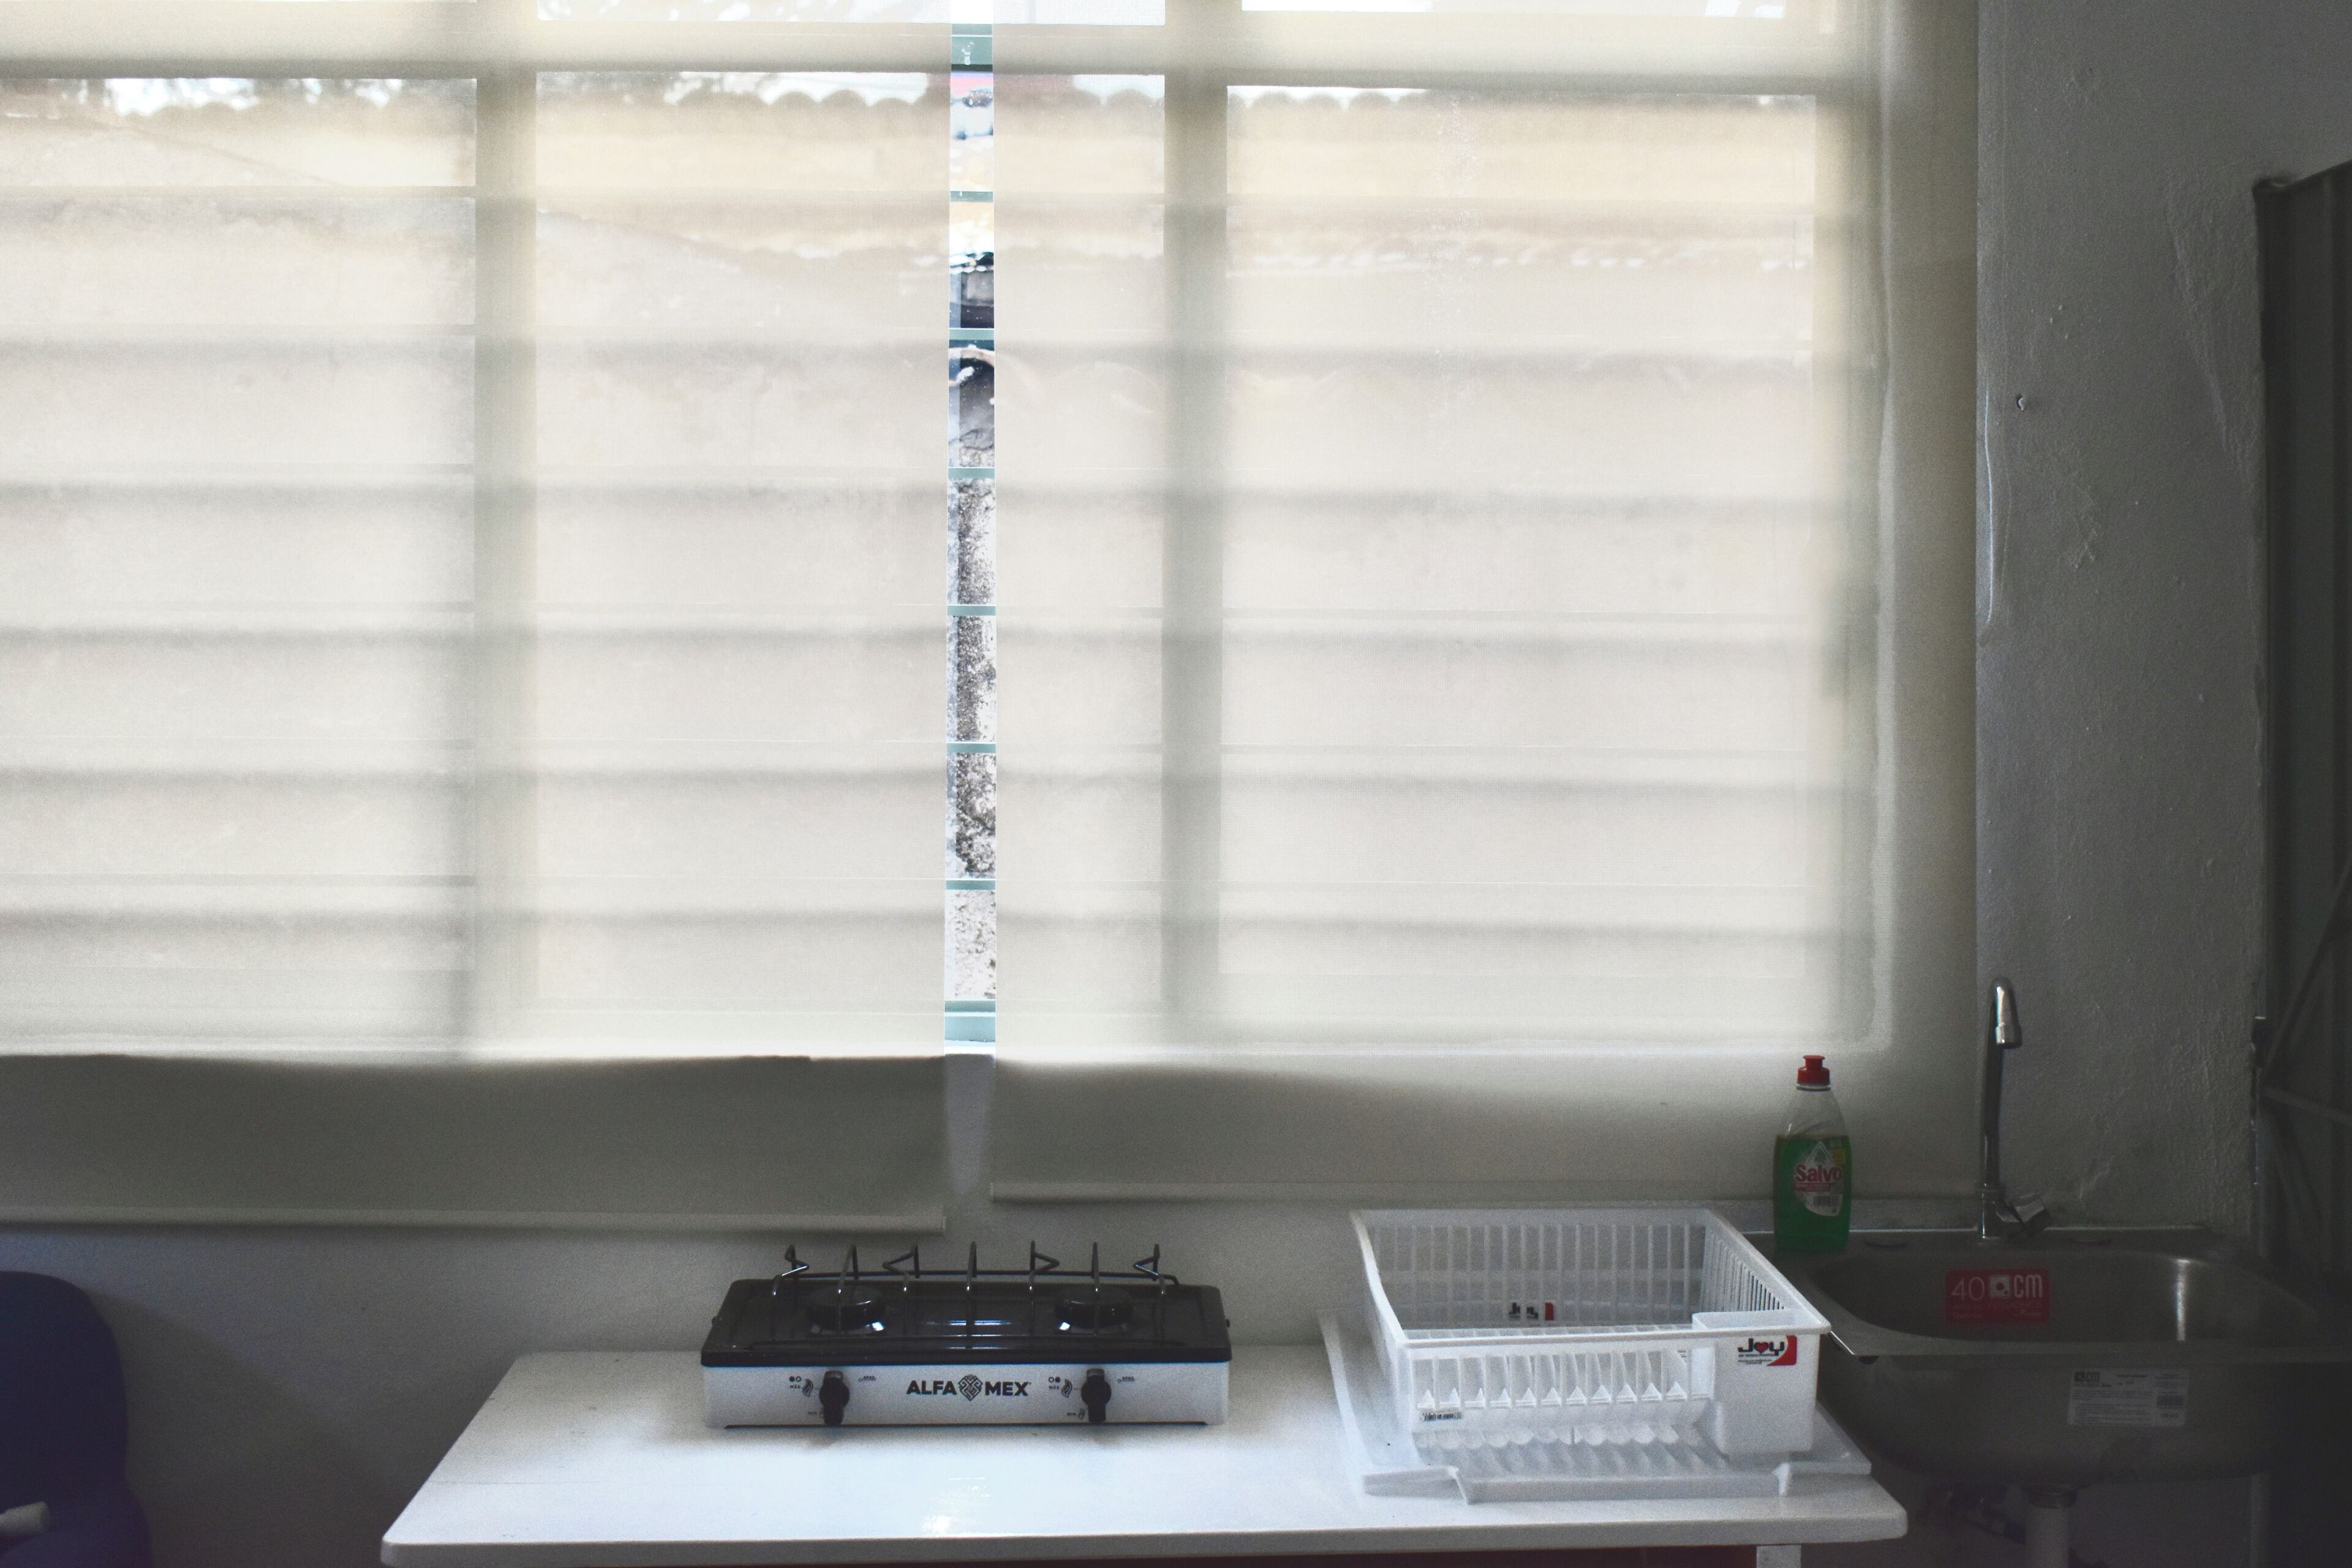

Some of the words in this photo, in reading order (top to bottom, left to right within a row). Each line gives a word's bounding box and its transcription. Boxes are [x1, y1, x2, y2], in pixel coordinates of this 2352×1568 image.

[1795, 1164, 1842, 1182] Salvo
[1950, 1276, 1985, 1302] 40
[906, 1380, 957, 1395] ALFA
[985, 1381, 1029, 1396] MEX
